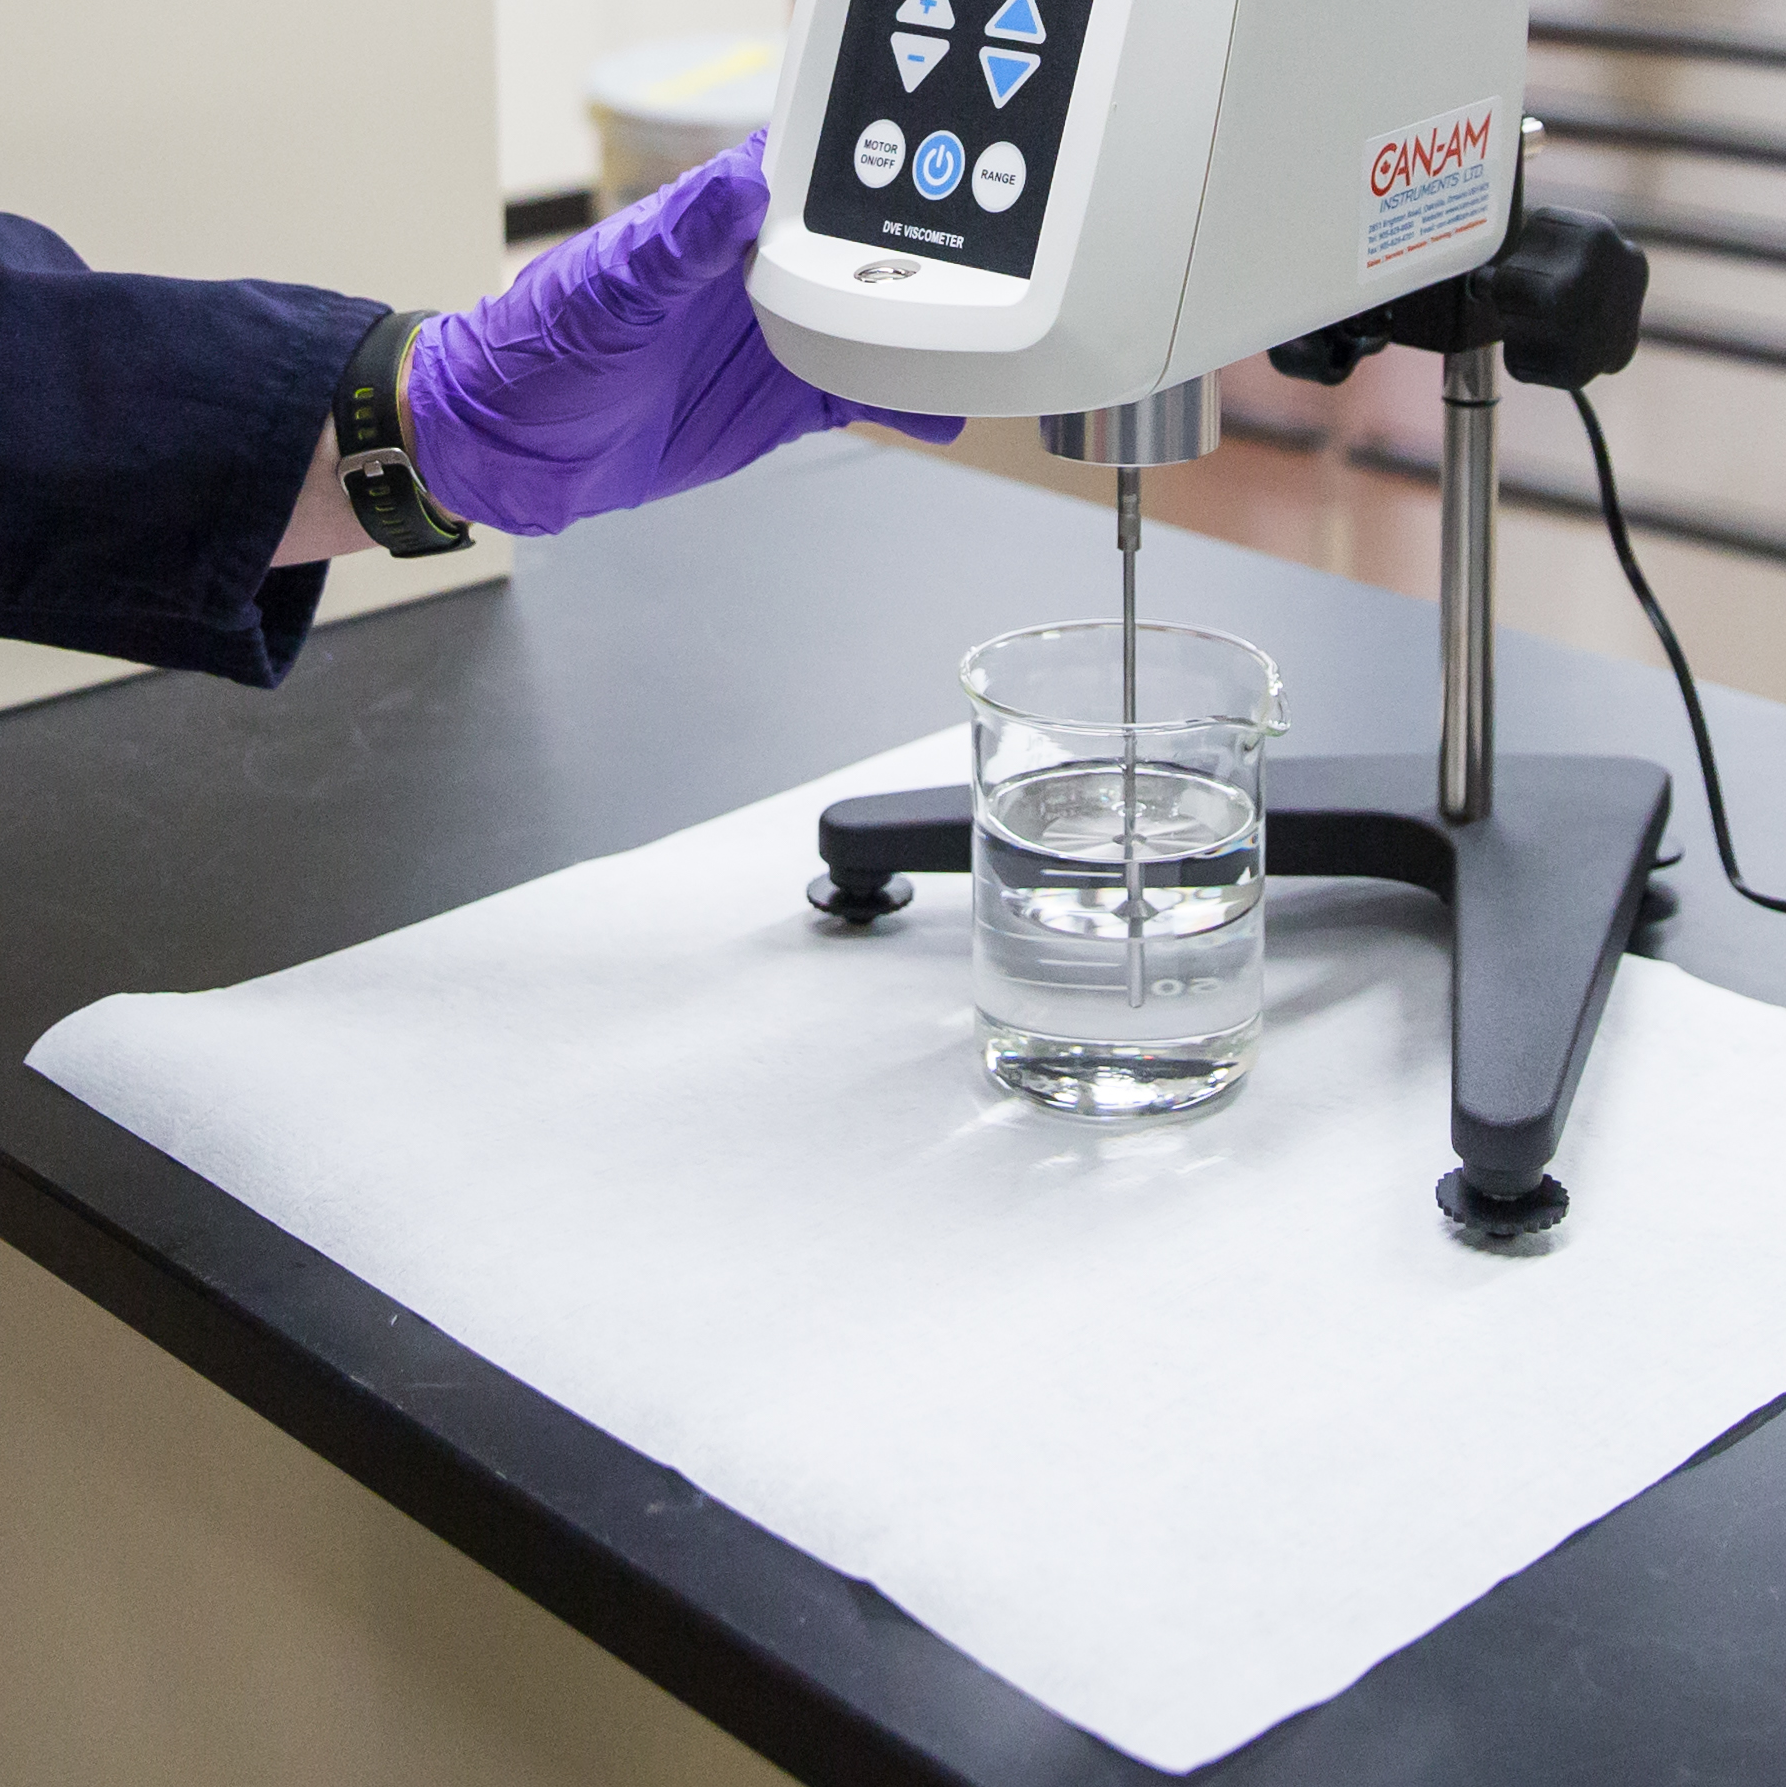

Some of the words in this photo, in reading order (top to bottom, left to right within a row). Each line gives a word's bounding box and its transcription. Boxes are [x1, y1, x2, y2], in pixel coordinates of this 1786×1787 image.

[863, 138, 899, 155] MOTOR
[1370, 108, 1493, 198] CAN-AM
[860, 153, 896, 170] ON/OFF
[980, 168, 1017, 186] RANGE
[1379, 171, 1461, 214] INSTRUMENTS
[882, 219, 903, 236] DVE
[904, 224, 965, 249] VISCOMETER
